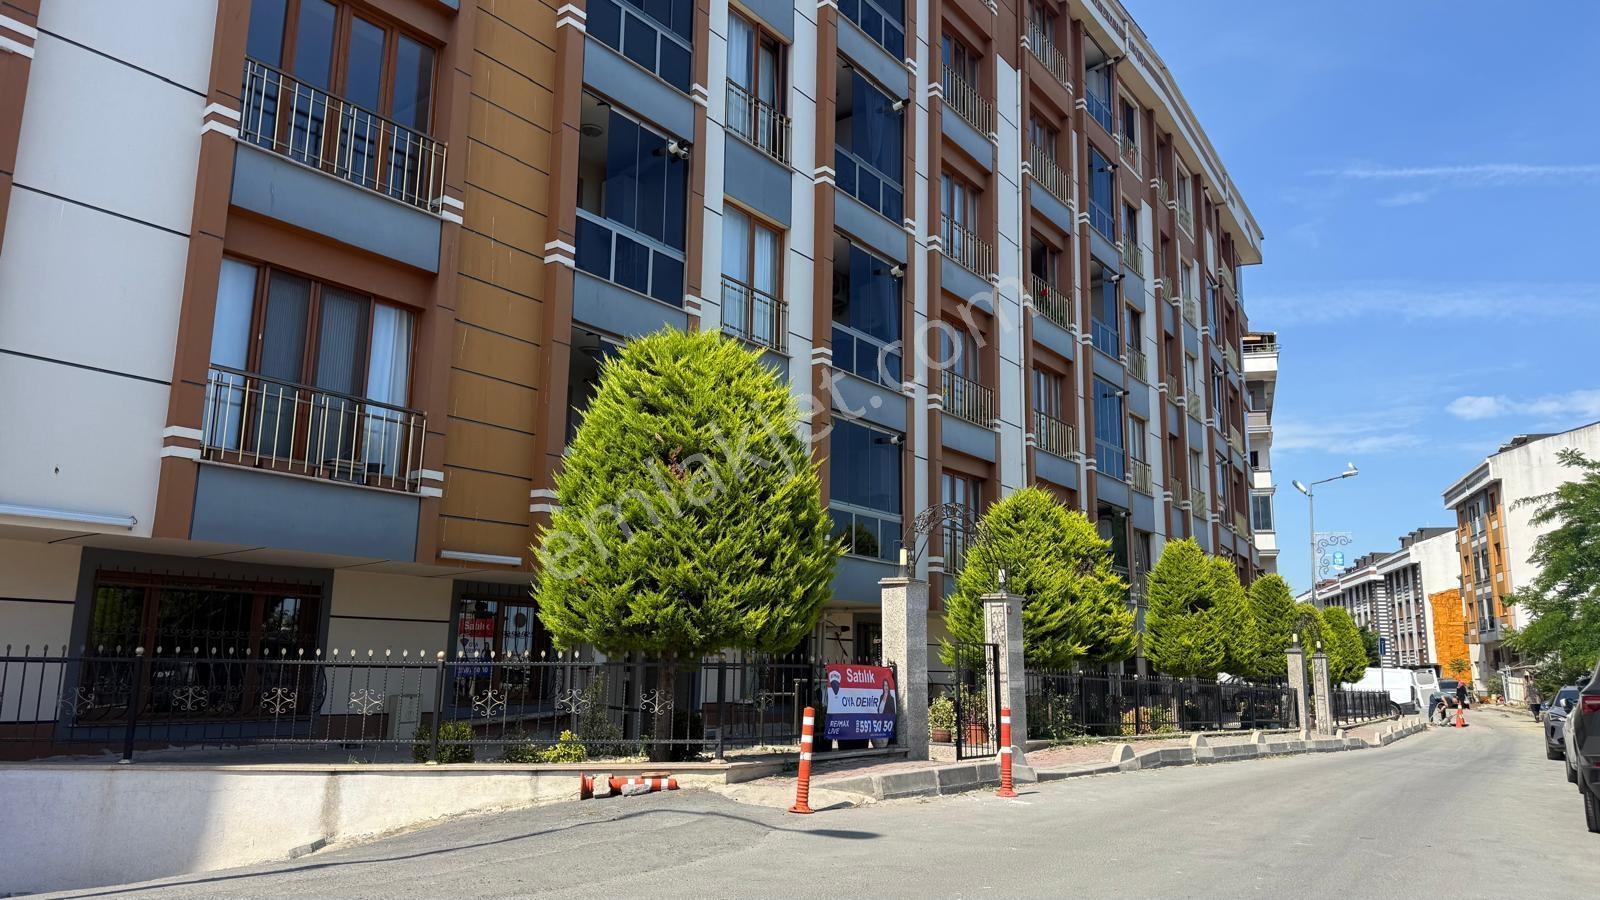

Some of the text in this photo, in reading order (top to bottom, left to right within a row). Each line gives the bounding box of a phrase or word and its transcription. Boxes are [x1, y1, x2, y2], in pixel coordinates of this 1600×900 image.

[846, 668, 875, 683] Satılık
[842, 696, 855, 707] OYA
[860, 720, 871, 733] 597
[873, 720, 881, 732] 50
